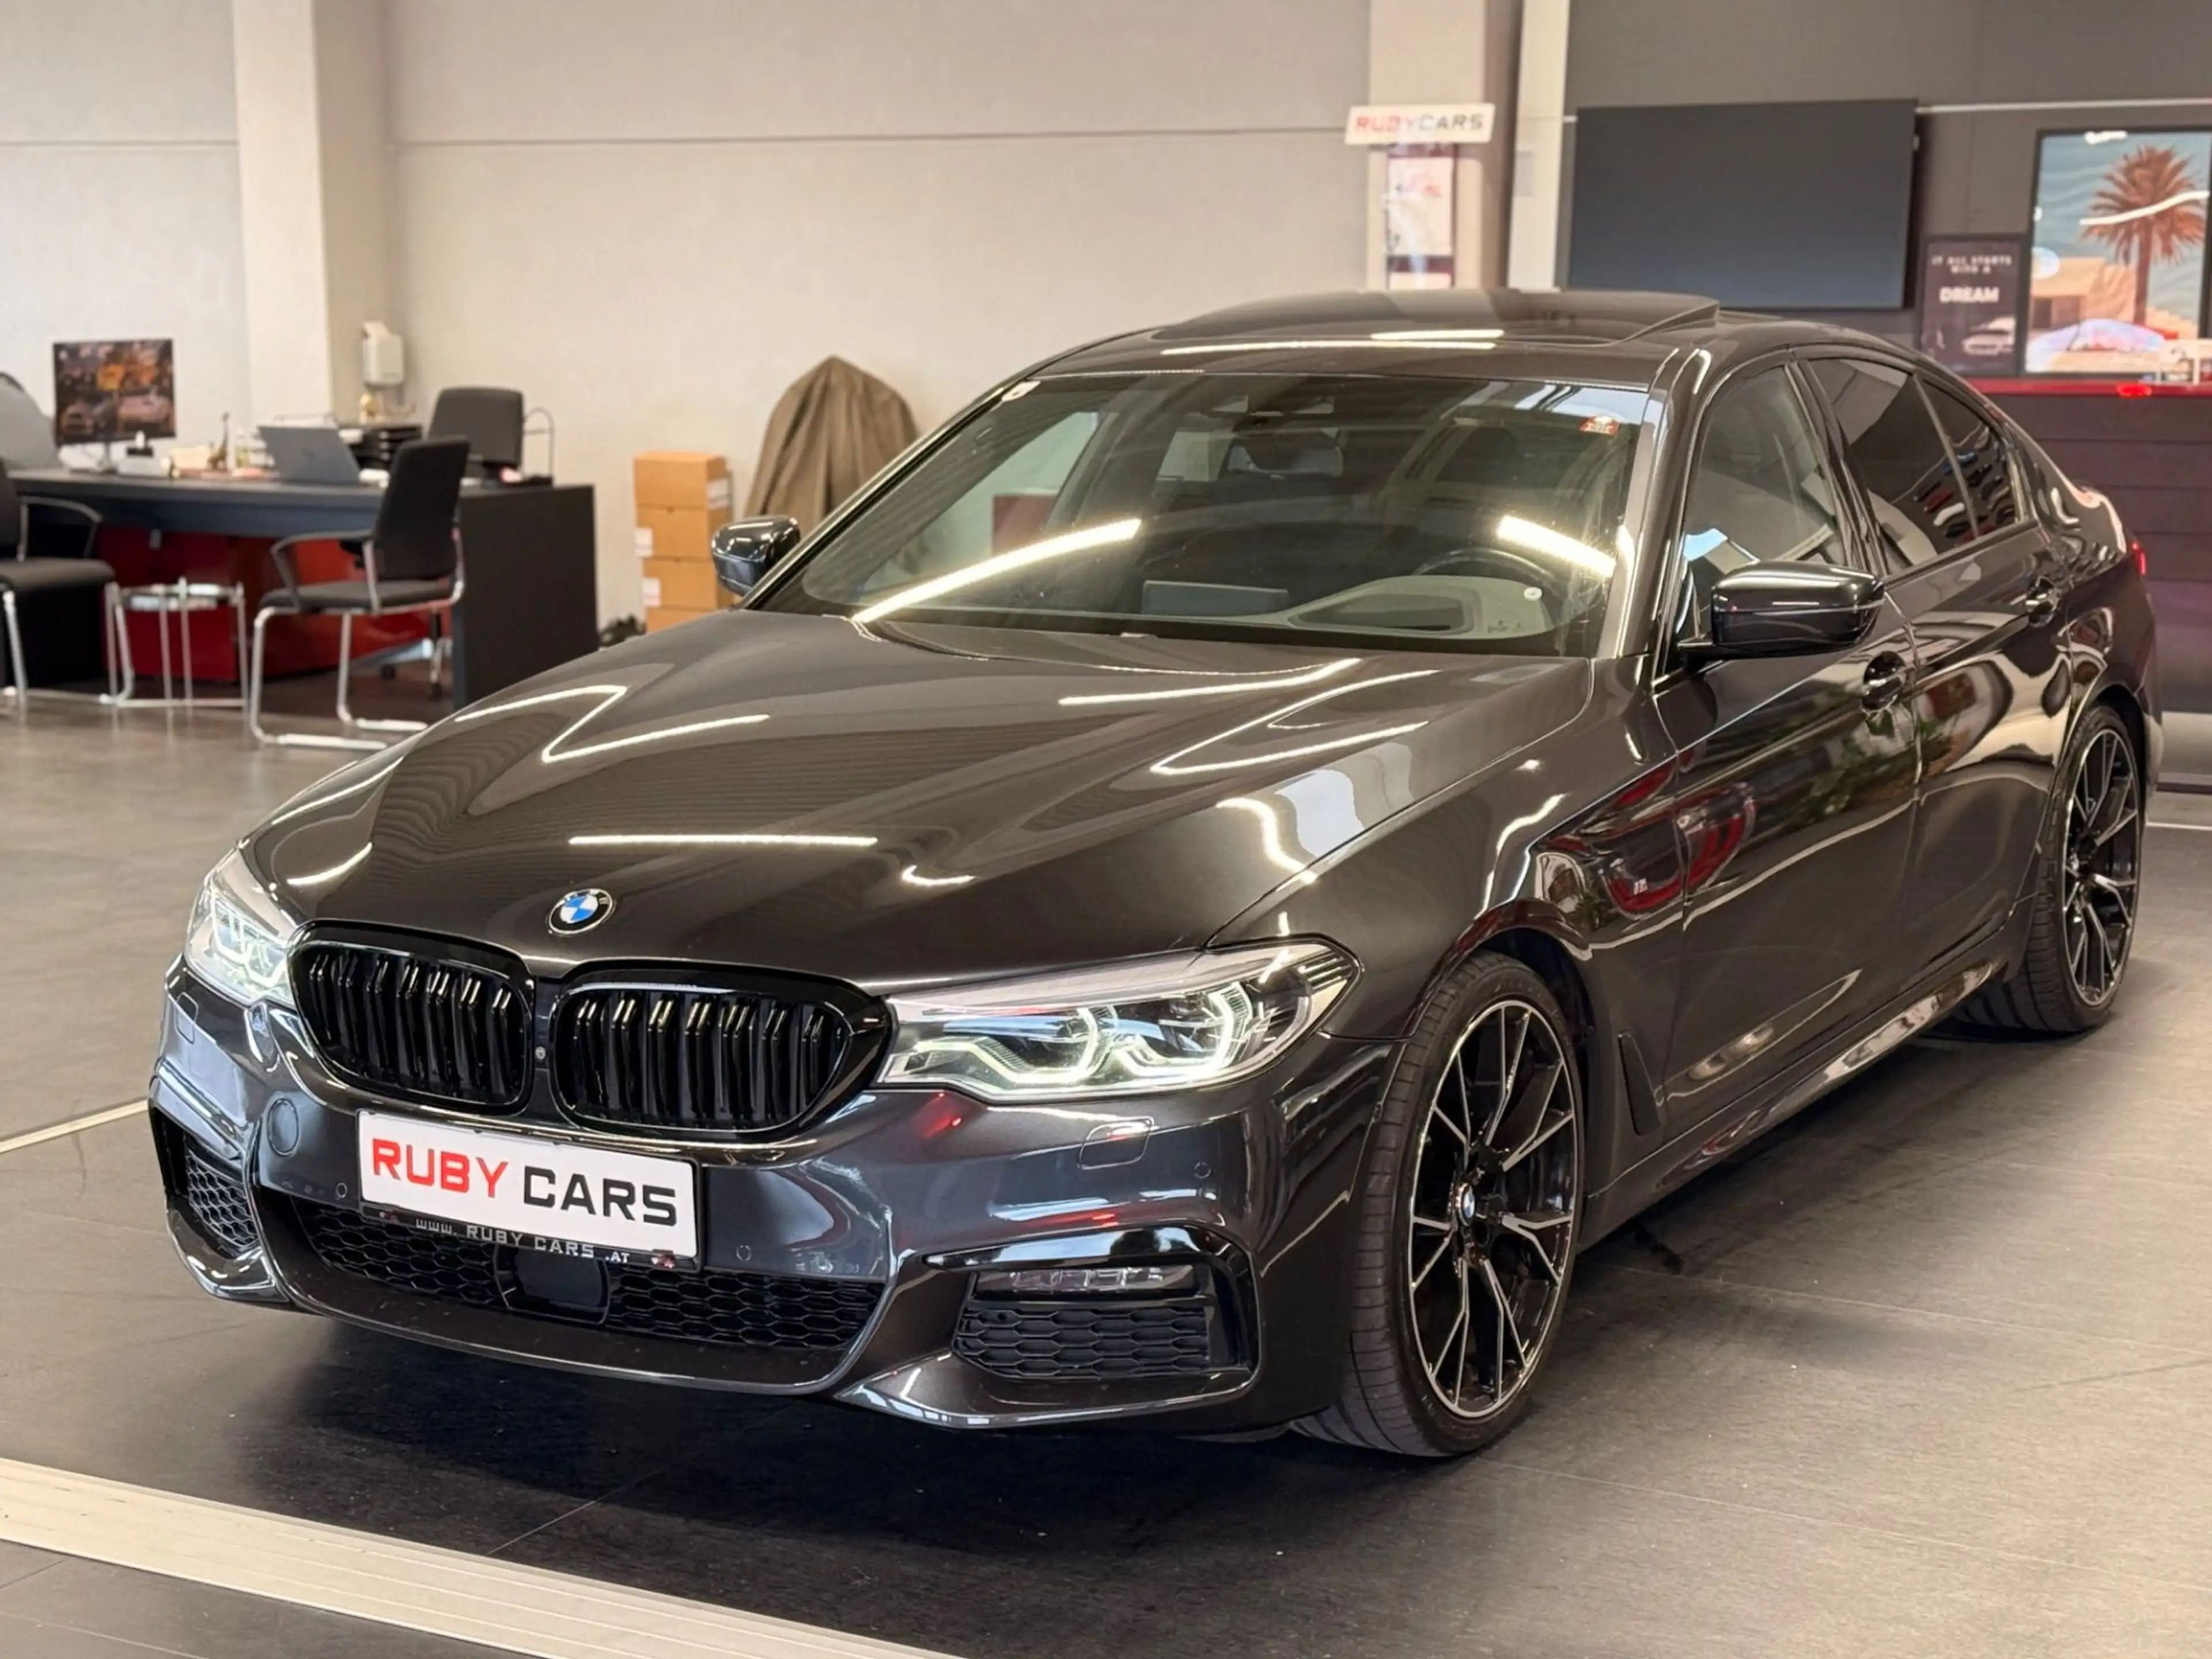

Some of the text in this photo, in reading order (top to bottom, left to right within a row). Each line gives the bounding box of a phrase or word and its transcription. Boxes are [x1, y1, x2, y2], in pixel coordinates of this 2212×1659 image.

[1939, 286, 2000, 303] DREAM
[372, 1138, 678, 1228] RUBY CARS
[466, 1224, 524, 1247] RUBY
[534, 1236, 594, 1258] CARS
